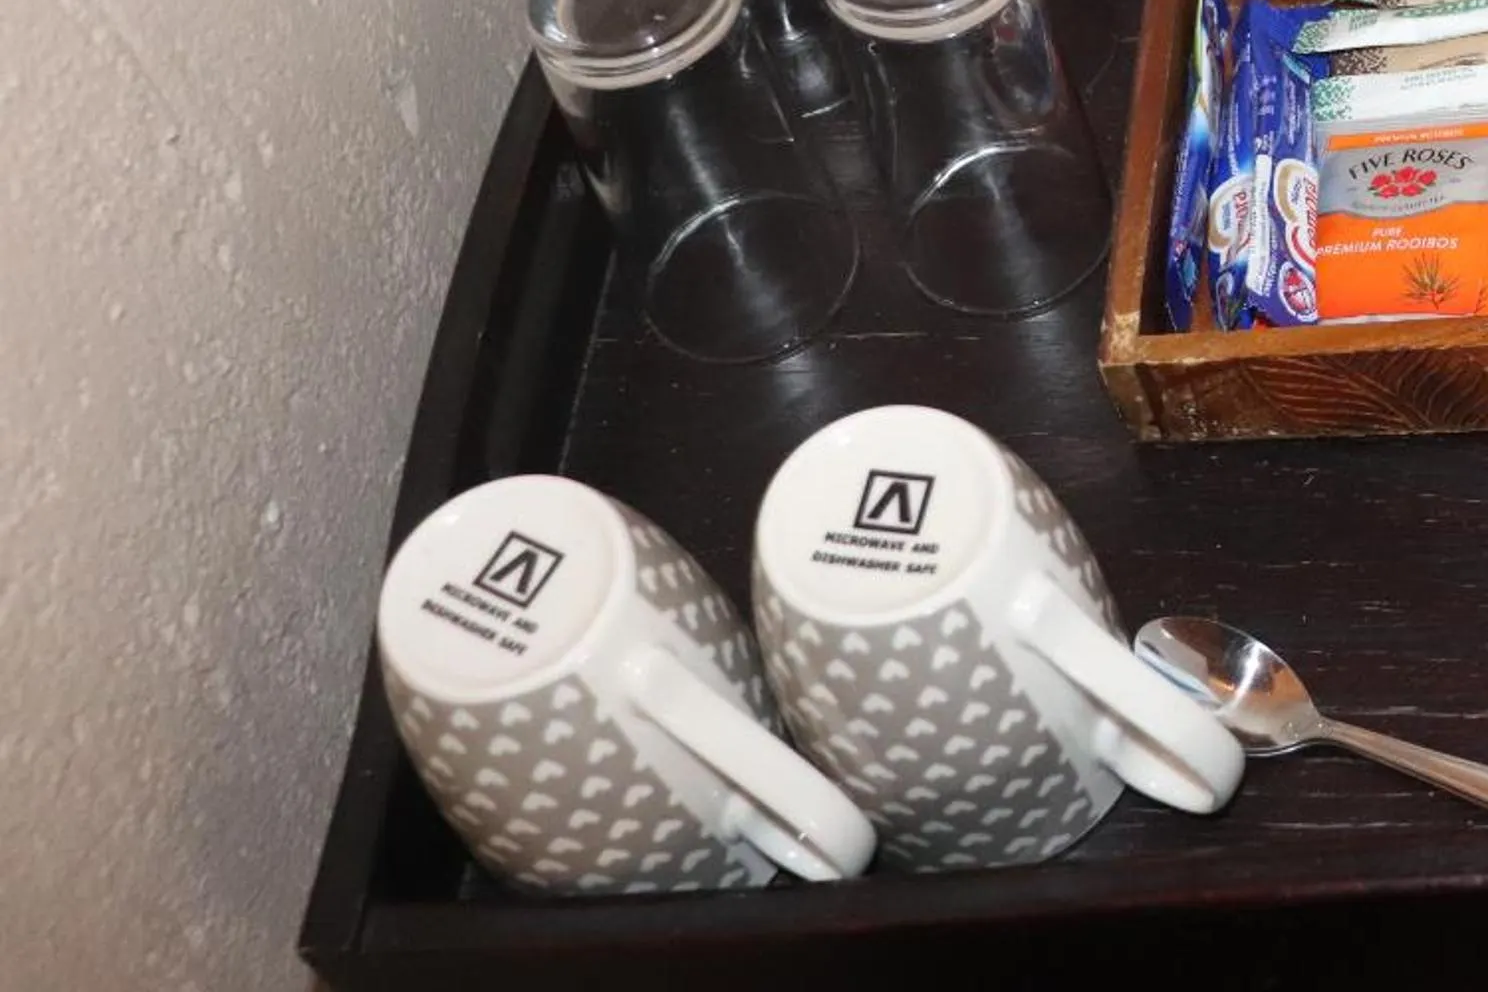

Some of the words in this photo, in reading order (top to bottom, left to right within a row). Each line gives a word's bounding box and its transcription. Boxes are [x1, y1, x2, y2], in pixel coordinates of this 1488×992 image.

[1348, 152, 1394, 180] FIVE
[1402, 147, 1475, 170] ROSES
[1316, 239, 1384, 256] PREMIUM
[1385, 236, 1460, 252] ROOIBOS
[825, 531, 906, 551] MICROWAVE
[911, 542, 940, 555] AND
[810, 550, 902, 572] DISHWASHER
[905, 562, 938, 575] SAFE
